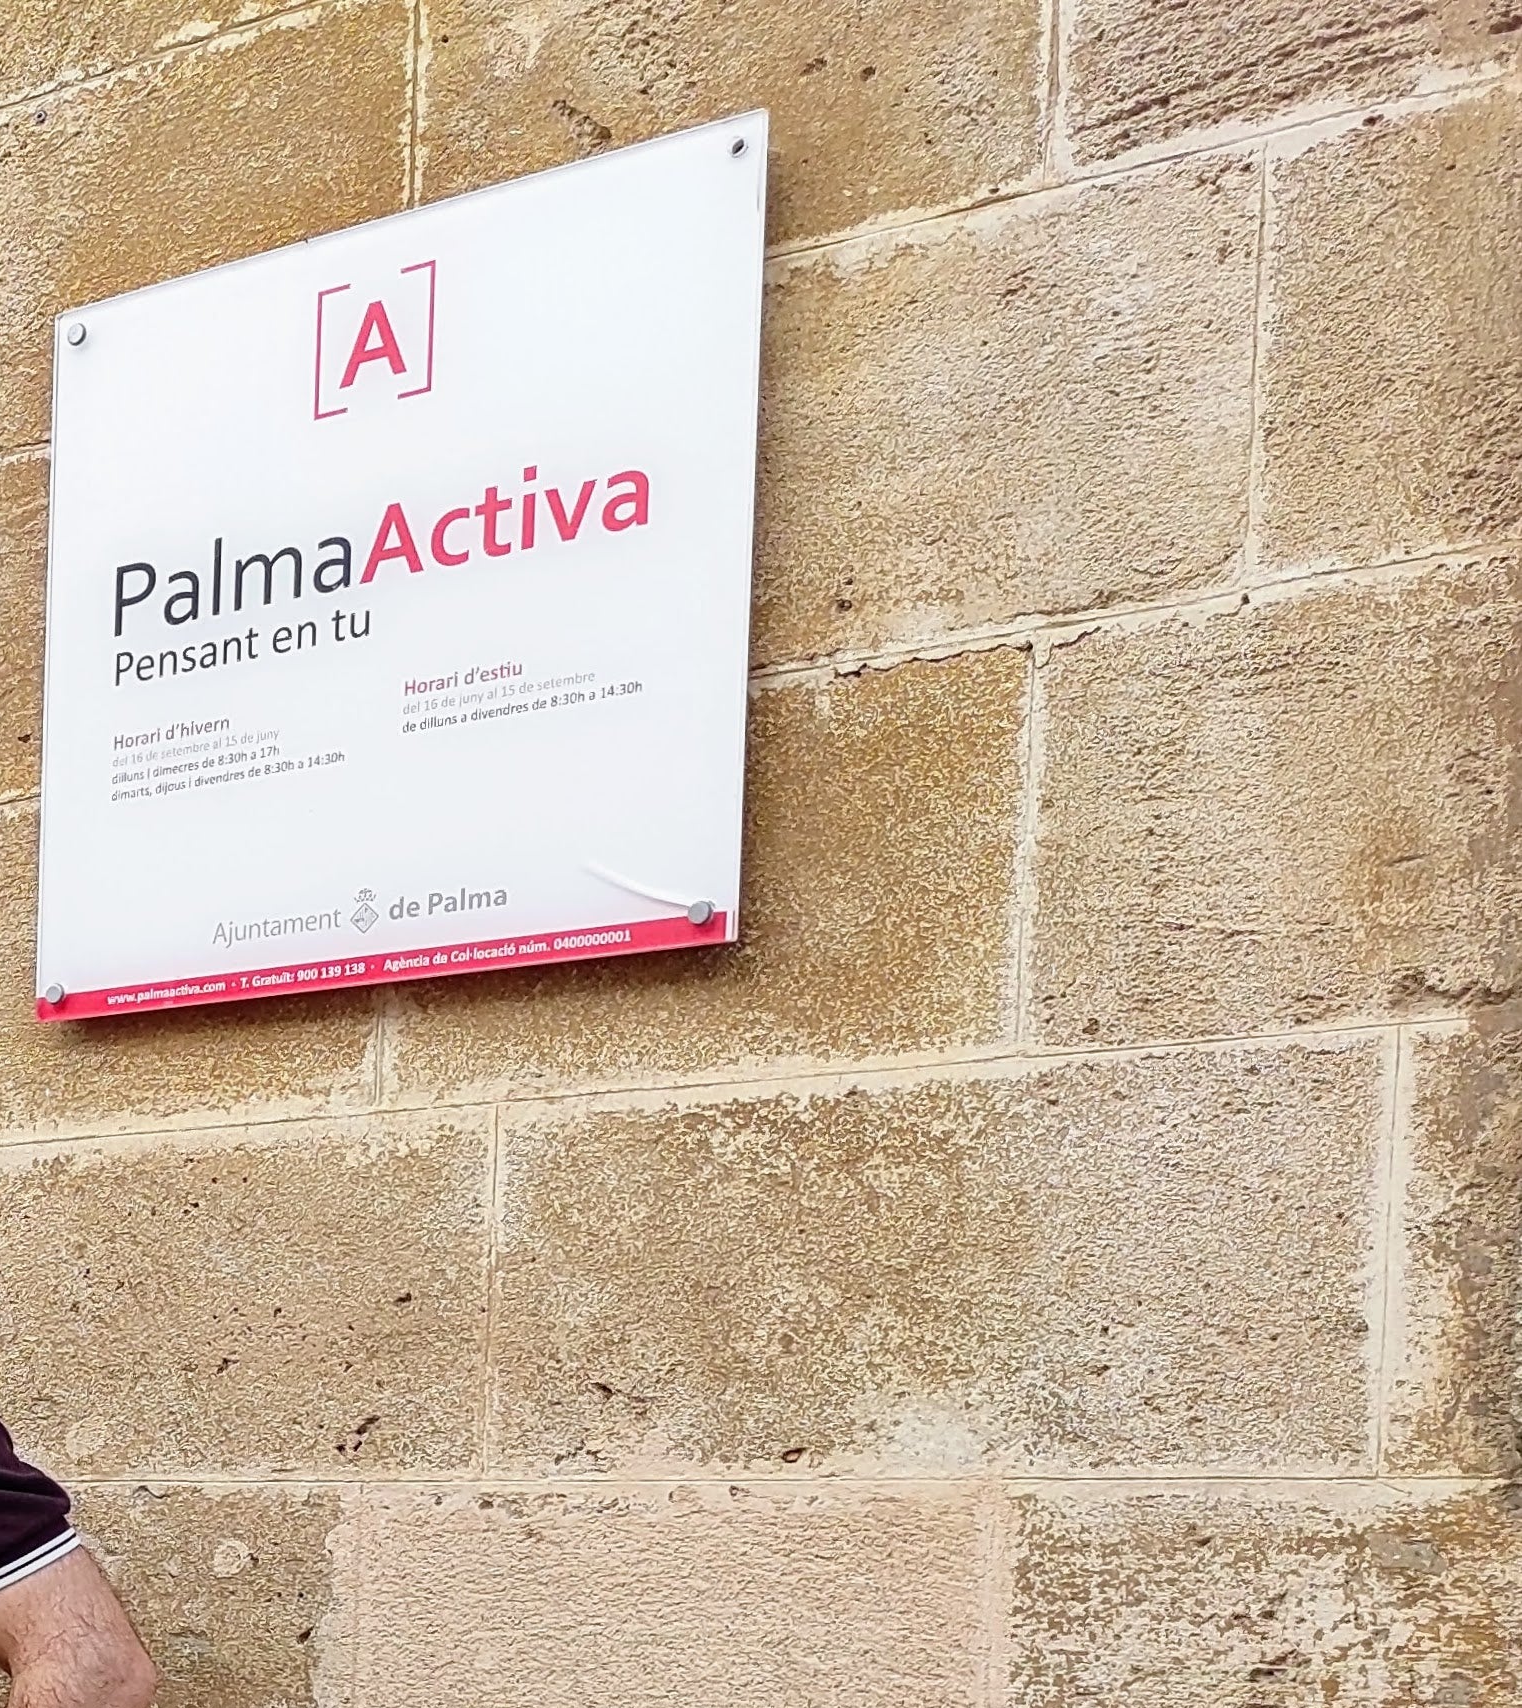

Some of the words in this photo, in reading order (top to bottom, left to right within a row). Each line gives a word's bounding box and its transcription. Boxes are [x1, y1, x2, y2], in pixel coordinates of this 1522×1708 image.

[113, 465, 651, 637] PalmaActiva
[114, 626, 259, 687] Pensant
[271, 615, 318, 654] en
[330, 607, 372, 642] tu
[401, 719, 418, 734] de
[419, 712, 459, 731] dilluns
[459, 711, 468, 724] a
[469, 701, 530, 722] divendres
[531, 697, 548, 712] de
[549, 690, 586, 708] 8:30h
[587, 689, 597, 702] a
[599, 679, 644, 701] 14:30h
[402, 701, 421, 716] del
[423, 697, 439, 713] 16
[440, 694, 457, 709] de
[457, 690, 485, 709] juny
[487, 685, 499, 701] al
[501, 683, 516, 698] 15
[518, 680, 535, 695] de
[536, 671, 597, 692] setembre
[403, 670, 460, 697] Horari
[111, 770, 146, 786] dilluns
[151, 760, 200, 779] dimecres
[201, 757, 216, 770] de
[216, 752, 248, 767] 8:30h
[249, 751, 258, 762] a
[259, 745, 281, 760] 17h
[112, 756, 128, 768] del
[131, 752, 144, 765] 16
[145, 749, 159, 763] de
[160, 742, 211, 761] setembre
[213, 738, 222, 750] al
[225, 735, 239, 748] 15
[240, 732, 255, 746] de
[255, 728, 280, 745] juny
[113, 727, 161, 751] Horari
[110, 784, 154, 803] dimarts,
[154, 778, 187, 797] dijous
[193, 767, 246, 788] divendres
[247, 765, 262, 779] de
[263, 759, 296, 775] 8:30h
[297, 758, 305, 770] a
[306, 750, 347, 769] 14:30h
[212, 908, 342, 949] Ajuntament
[388, 895, 422, 921] de
[427, 886, 509, 916] Palma
[106, 980, 227, 1006] www.palmaactiva.com
[239, 976, 251, 989] T.
[296, 967, 319, 982] 900
[320, 964, 342, 980] 139
[343, 961, 367, 977] 138
[382, 953, 431, 973] Agència
[431, 951, 449, 965] de
[518, 939, 551, 956] núm.
